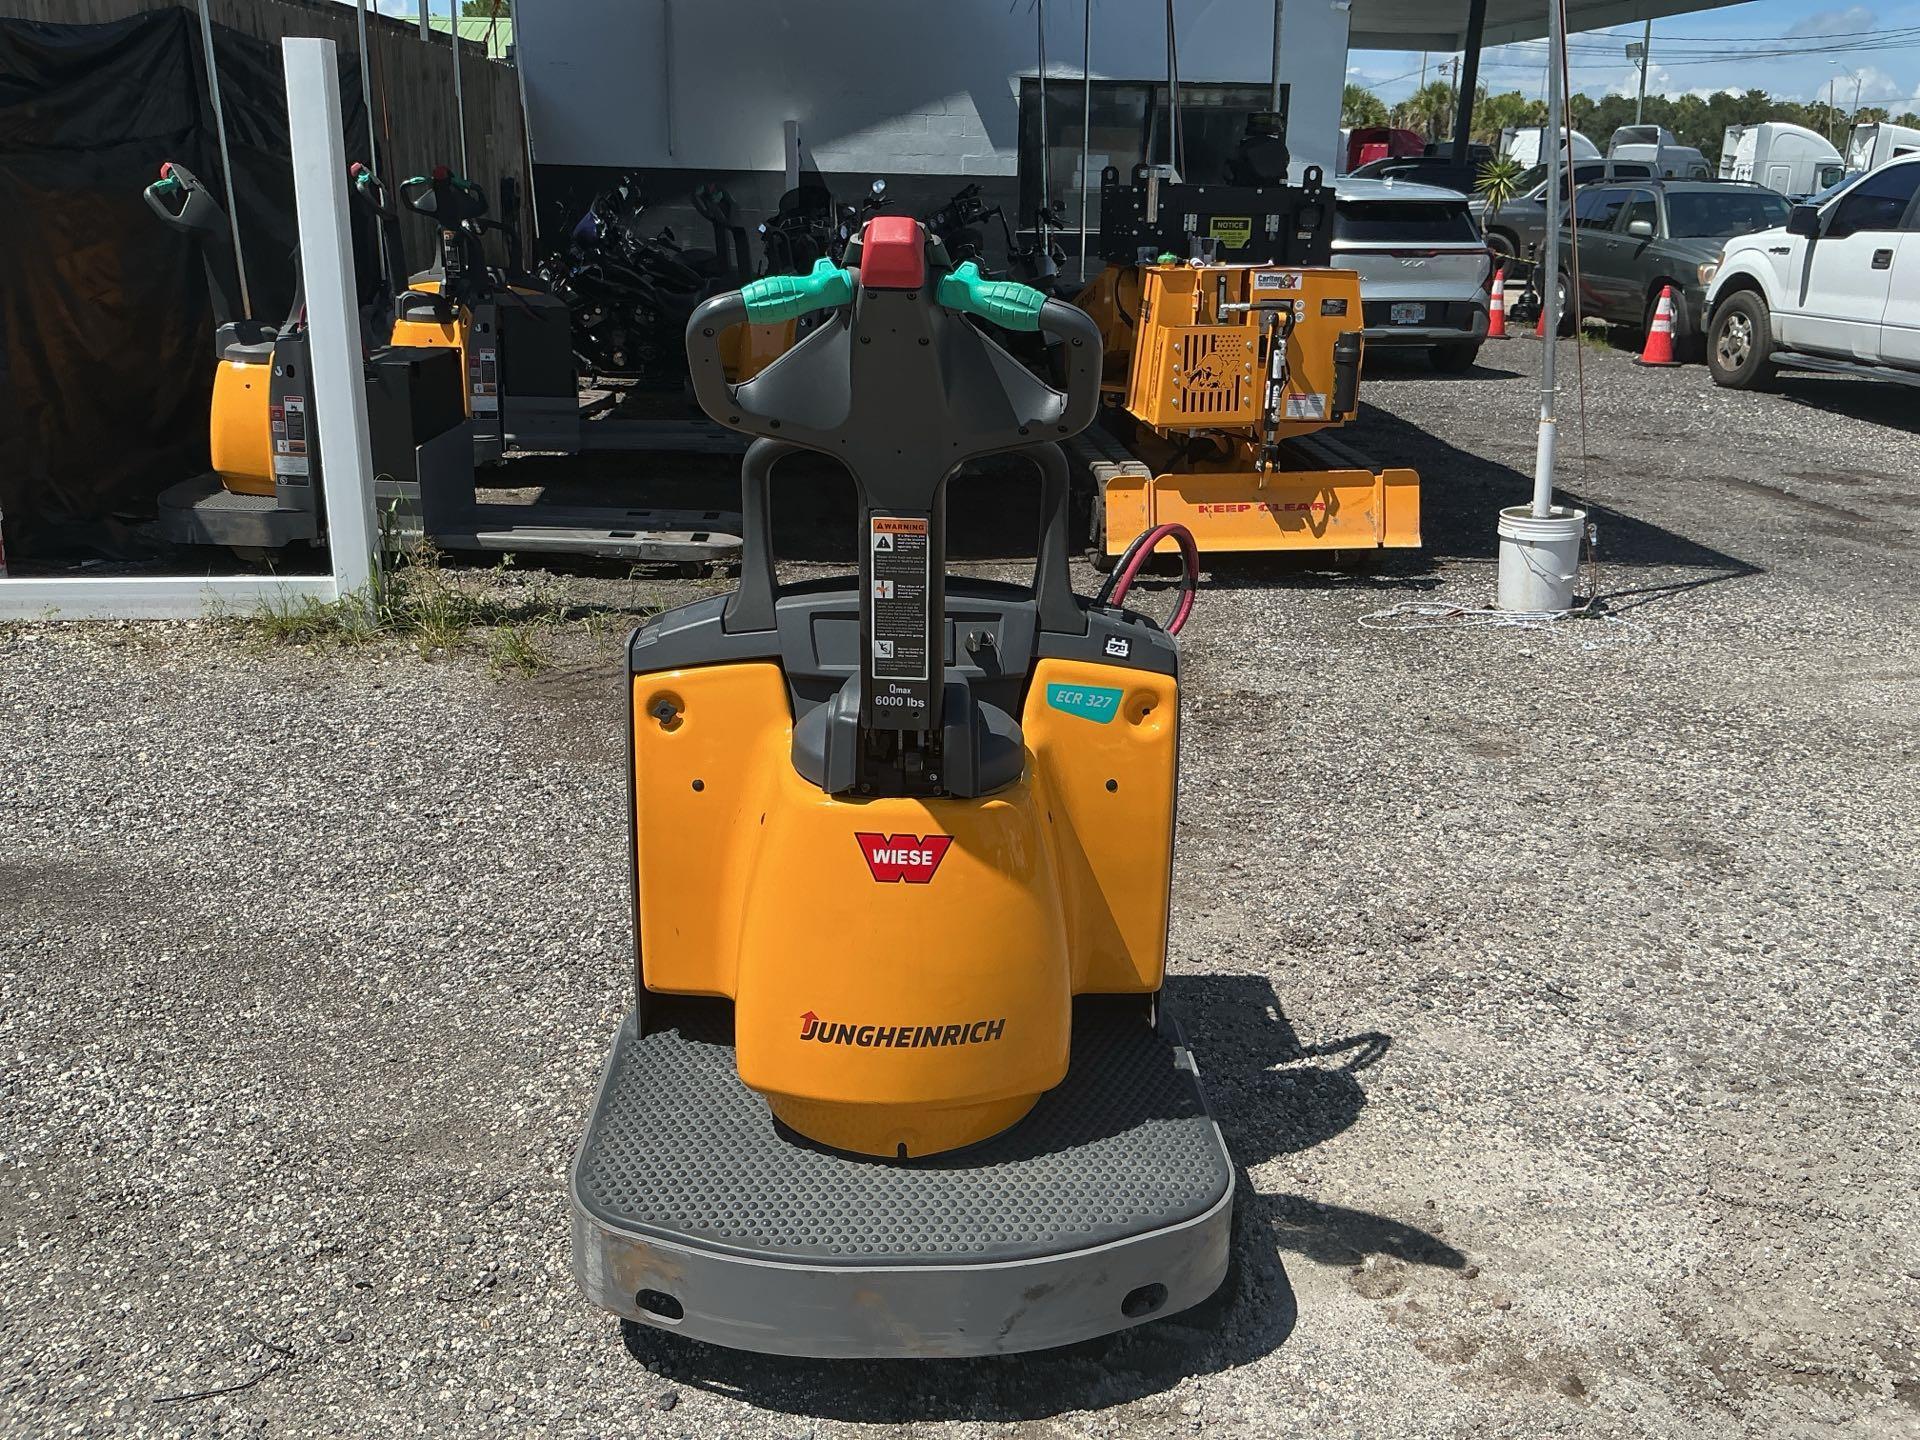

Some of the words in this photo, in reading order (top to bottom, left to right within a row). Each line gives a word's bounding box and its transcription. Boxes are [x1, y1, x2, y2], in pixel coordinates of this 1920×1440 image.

[1217, 221, 1245, 229] NOTICE
[1198, 504, 1251, 513] KEEP
[1258, 502, 1326, 512] CLEAR
[885, 523, 925, 531] WARNING
[889, 683, 912, 695] Qmax
[875, 695, 904, 707] 6000
[907, 697, 926, 708] lbs
[1055, 690, 1084, 705] ECR
[1085, 694, 1113, 708] 327
[872, 848, 933, 866] WIESE
[800, 1017, 1006, 1048] JUNGHEINRICH
